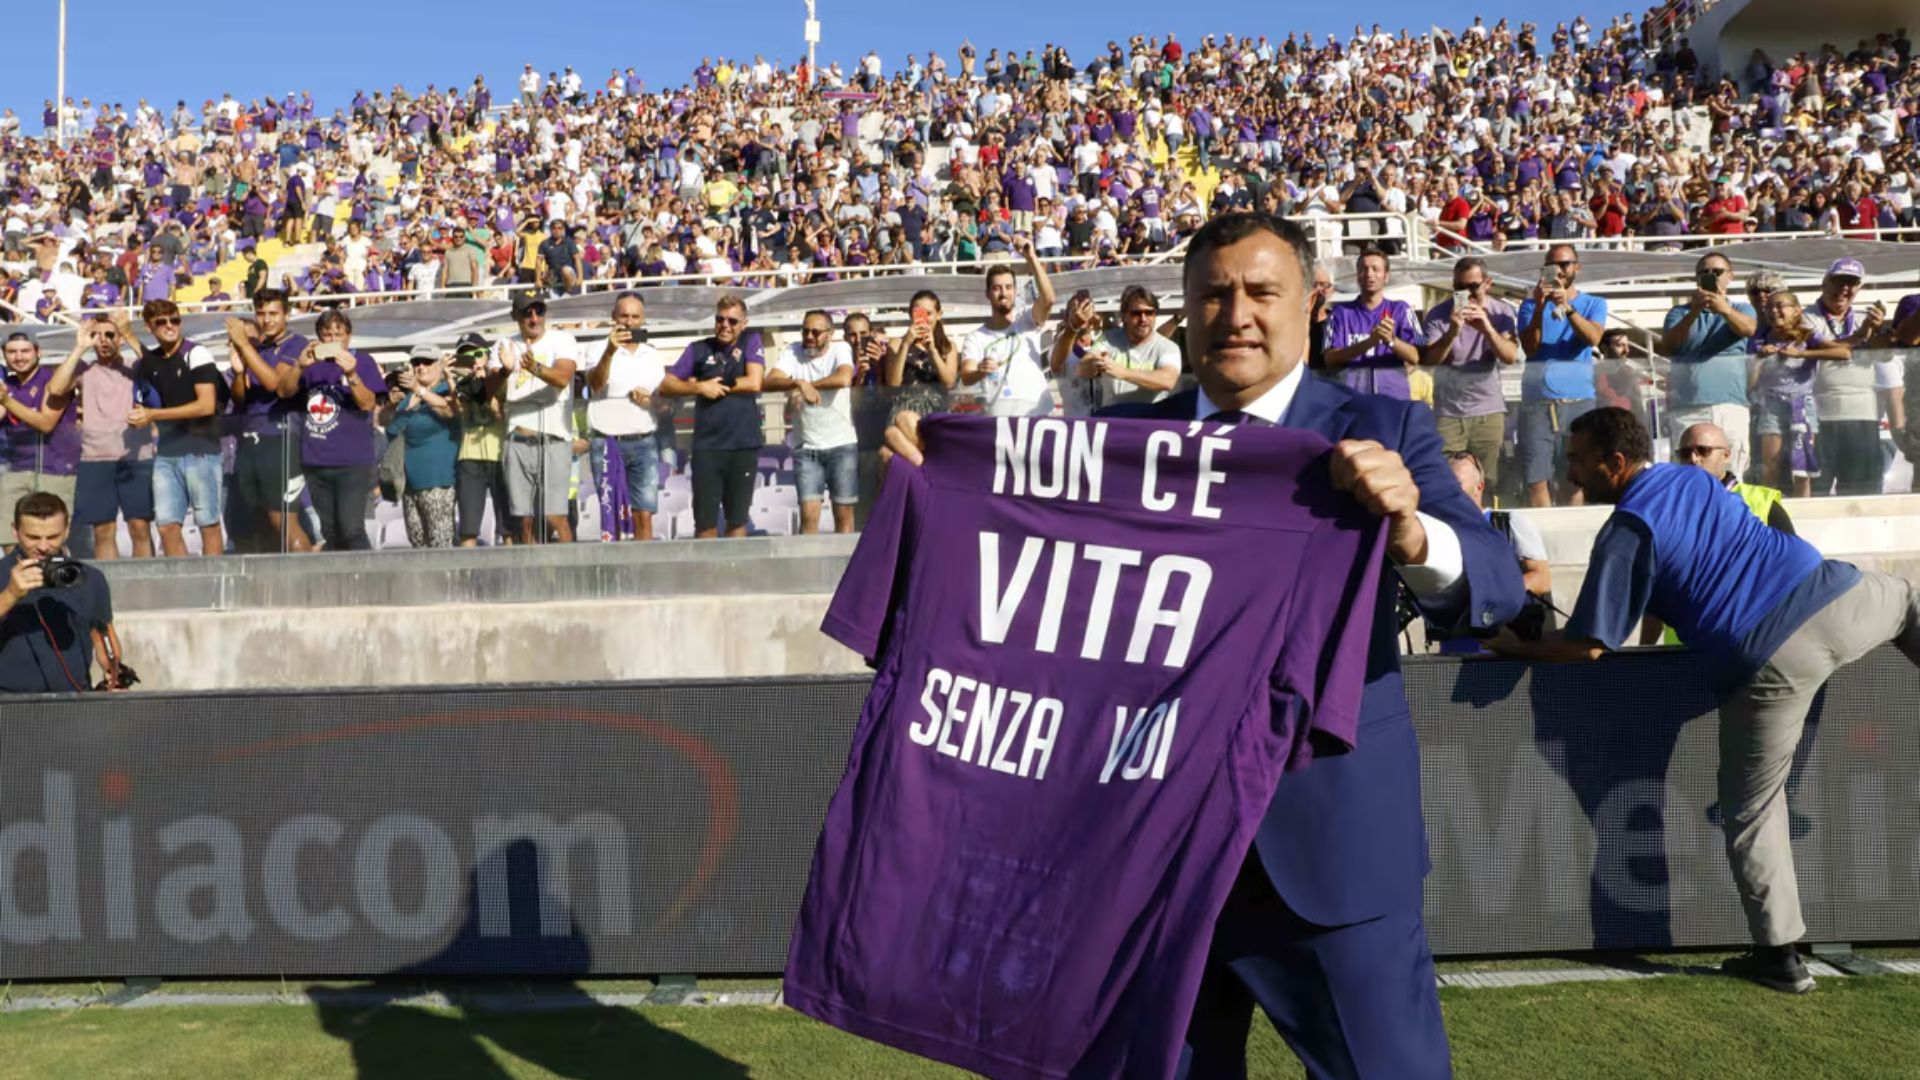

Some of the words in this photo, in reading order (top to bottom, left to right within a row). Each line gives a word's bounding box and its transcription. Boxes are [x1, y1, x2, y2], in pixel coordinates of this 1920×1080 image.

[992, 416, 1109, 503] NON
[978, 530, 1213, 669] VITA
[908, 667, 1064, 780] SENZA
[1098, 697, 1181, 784] VOI
[0, 769, 634, 945] diacom
